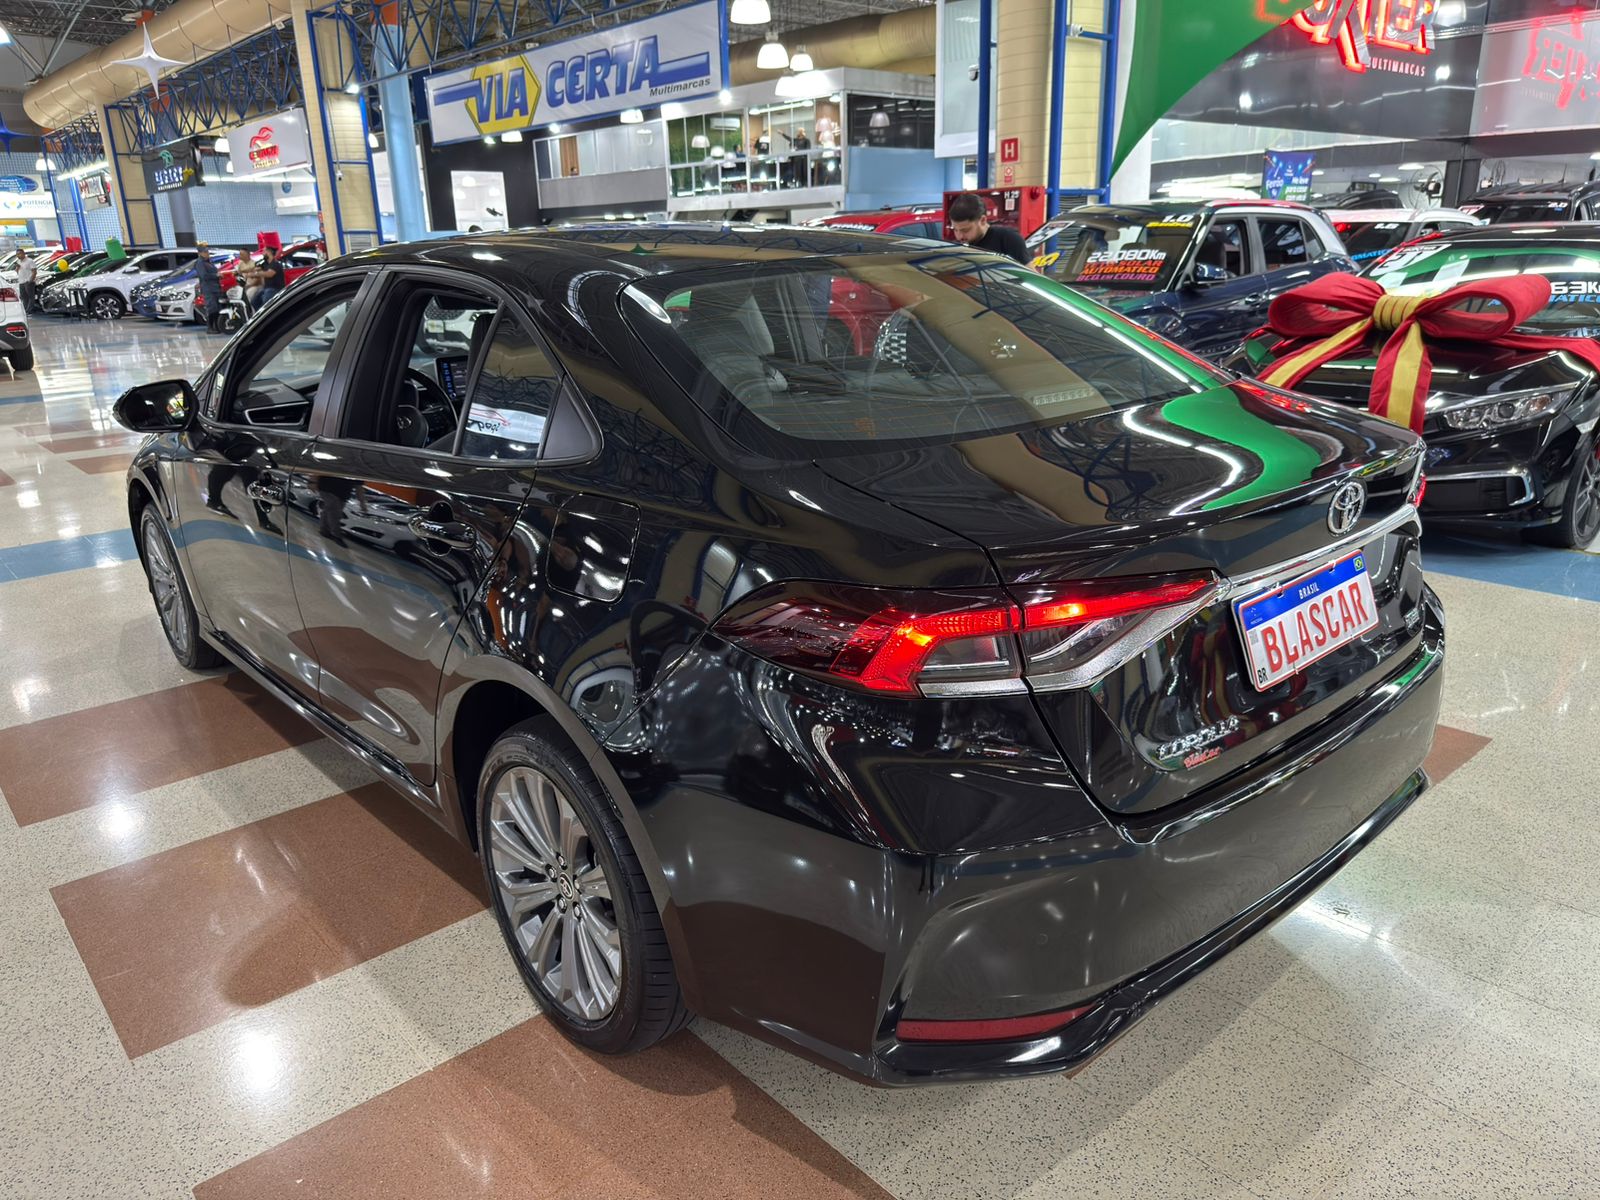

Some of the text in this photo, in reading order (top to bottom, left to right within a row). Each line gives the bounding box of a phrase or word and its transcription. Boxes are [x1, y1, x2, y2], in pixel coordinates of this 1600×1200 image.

[1366, 57, 1426, 77] ULTIMARCAS
[476, 34, 660, 124] VIA CERTA
[649, 78, 711, 97] Multimarcas
[1162, 213, 1195, 223] 1.0
[1551, 281, 1600, 294] 63K
[1298, 582, 1320, 600] BRASIL
[1260, 581, 1369, 674] BLASCAR
[1257, 667, 1268, 684] BR
